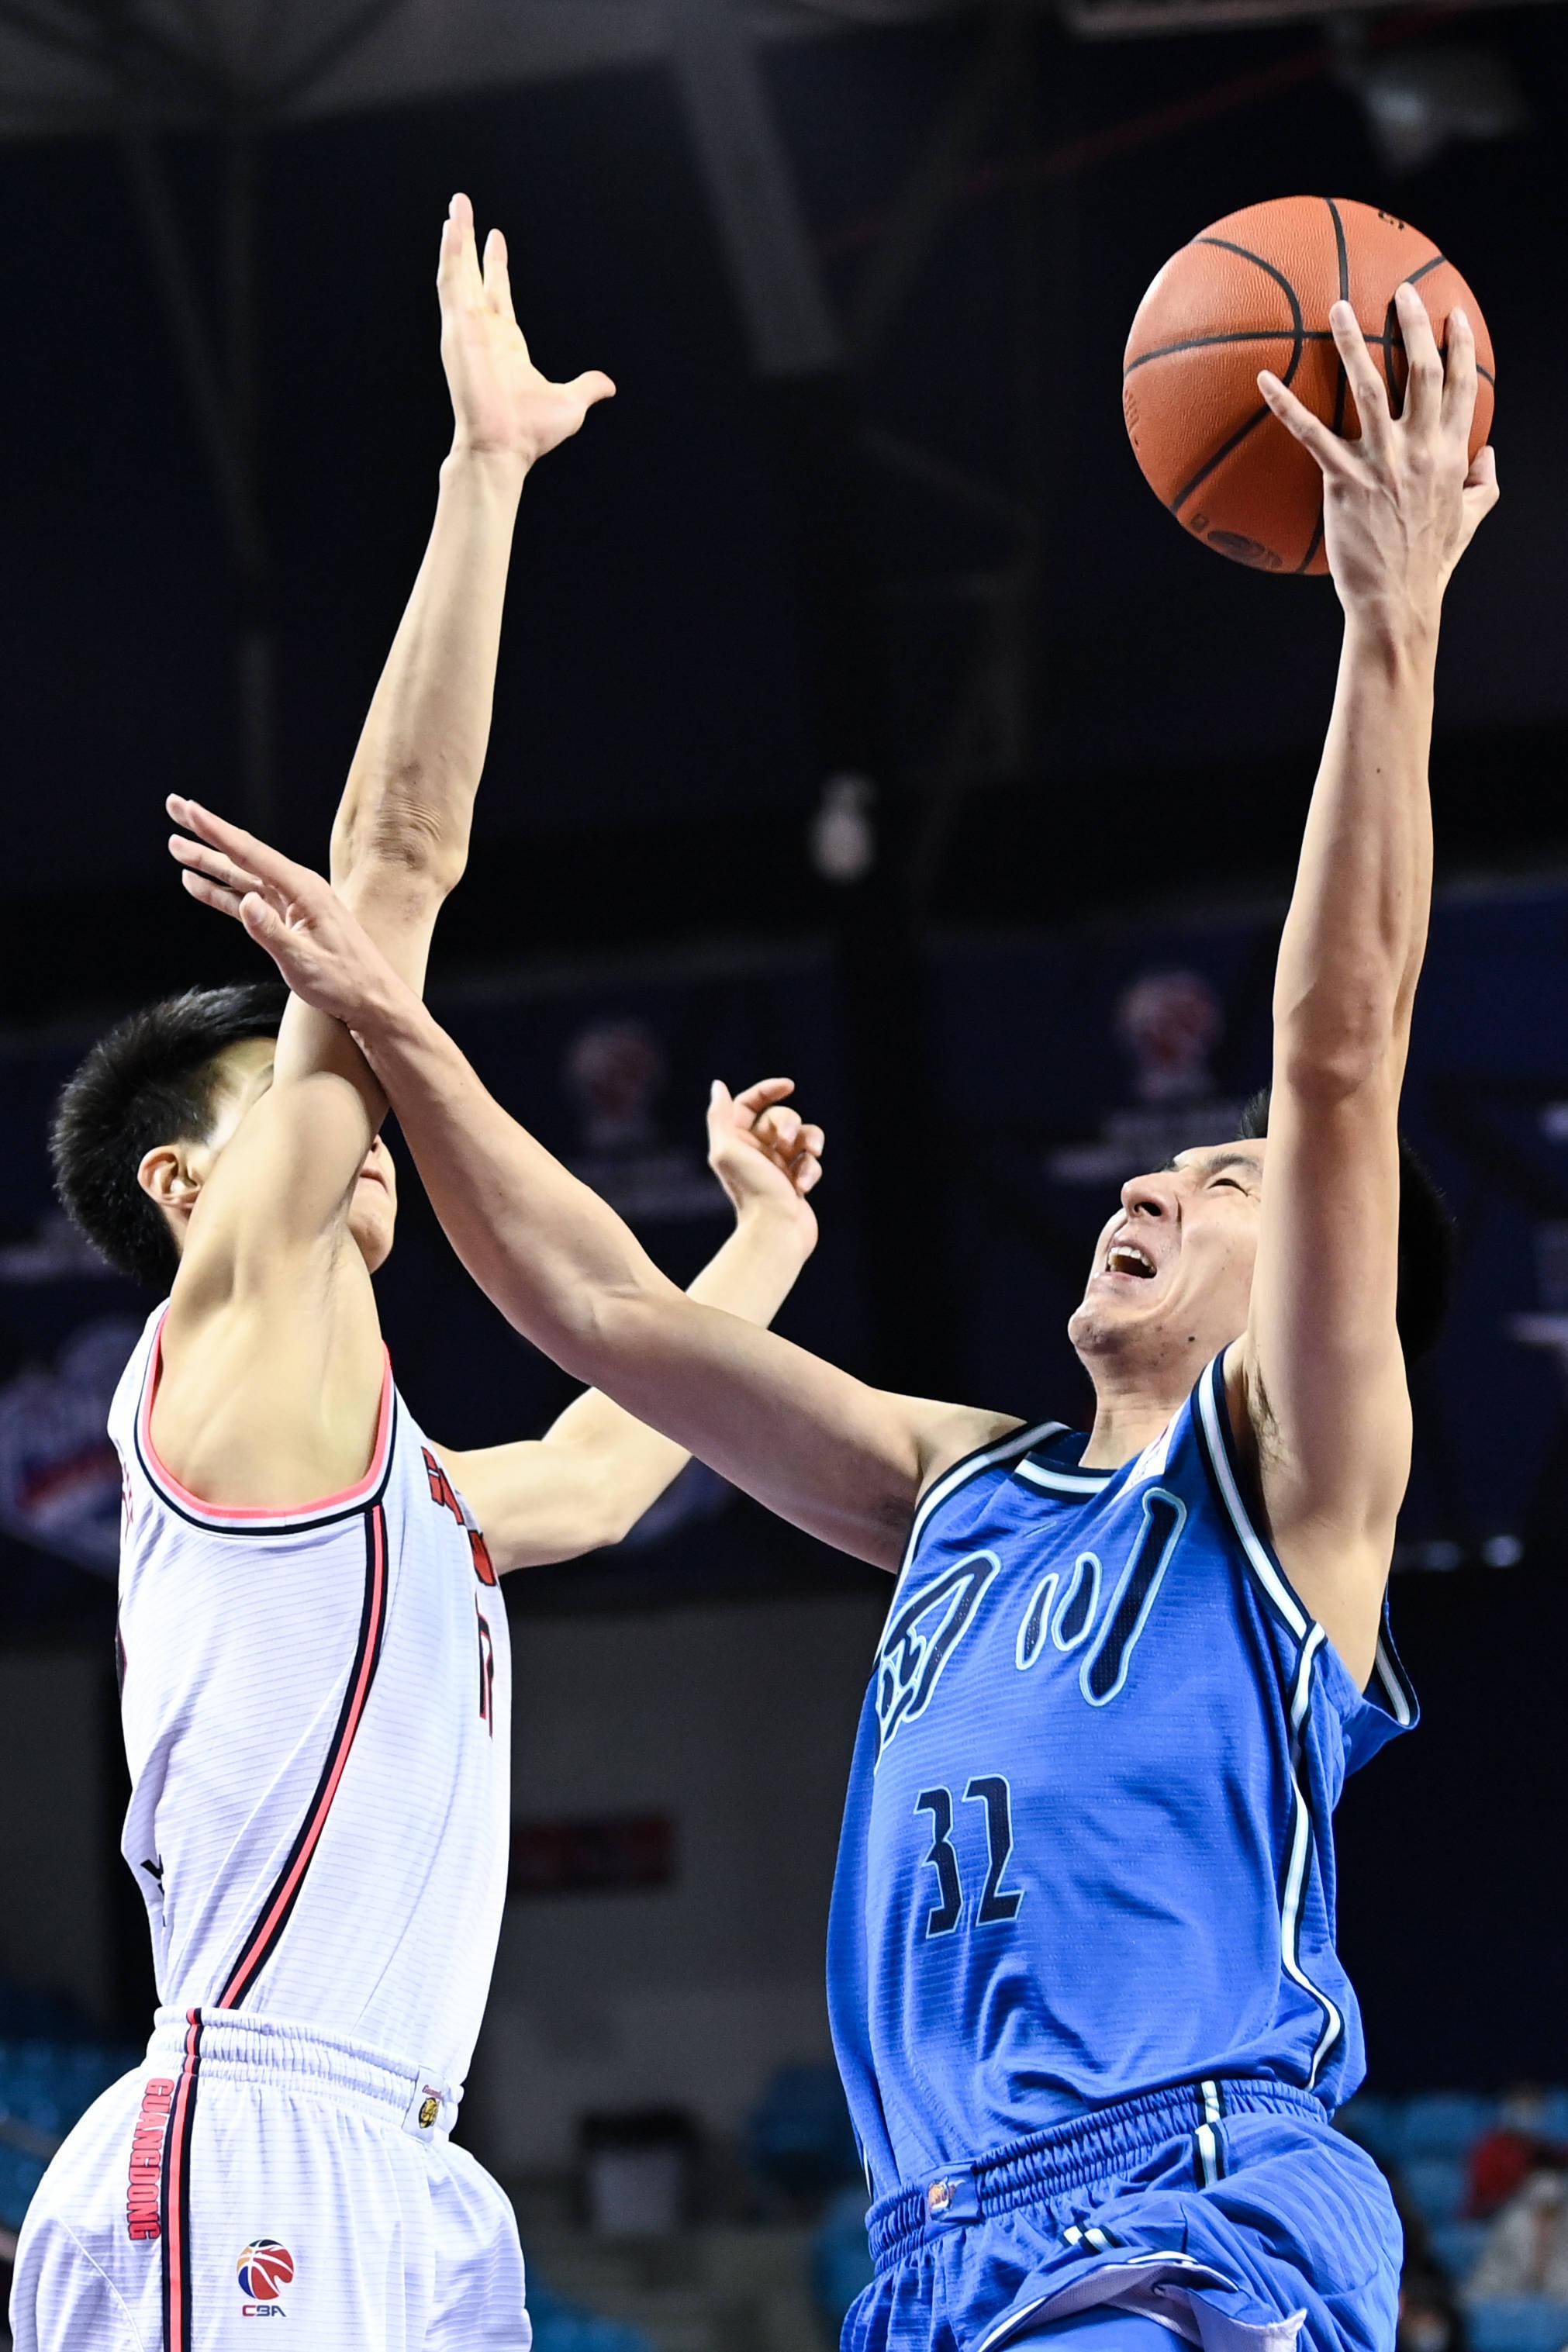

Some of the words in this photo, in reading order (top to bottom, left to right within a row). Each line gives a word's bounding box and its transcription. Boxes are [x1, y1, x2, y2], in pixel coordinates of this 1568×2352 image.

[914, 1773, 1025, 1939] 32
[127, 2077, 174, 2240] GUANGDONG
[242, 2305, 287, 2317] CBA
